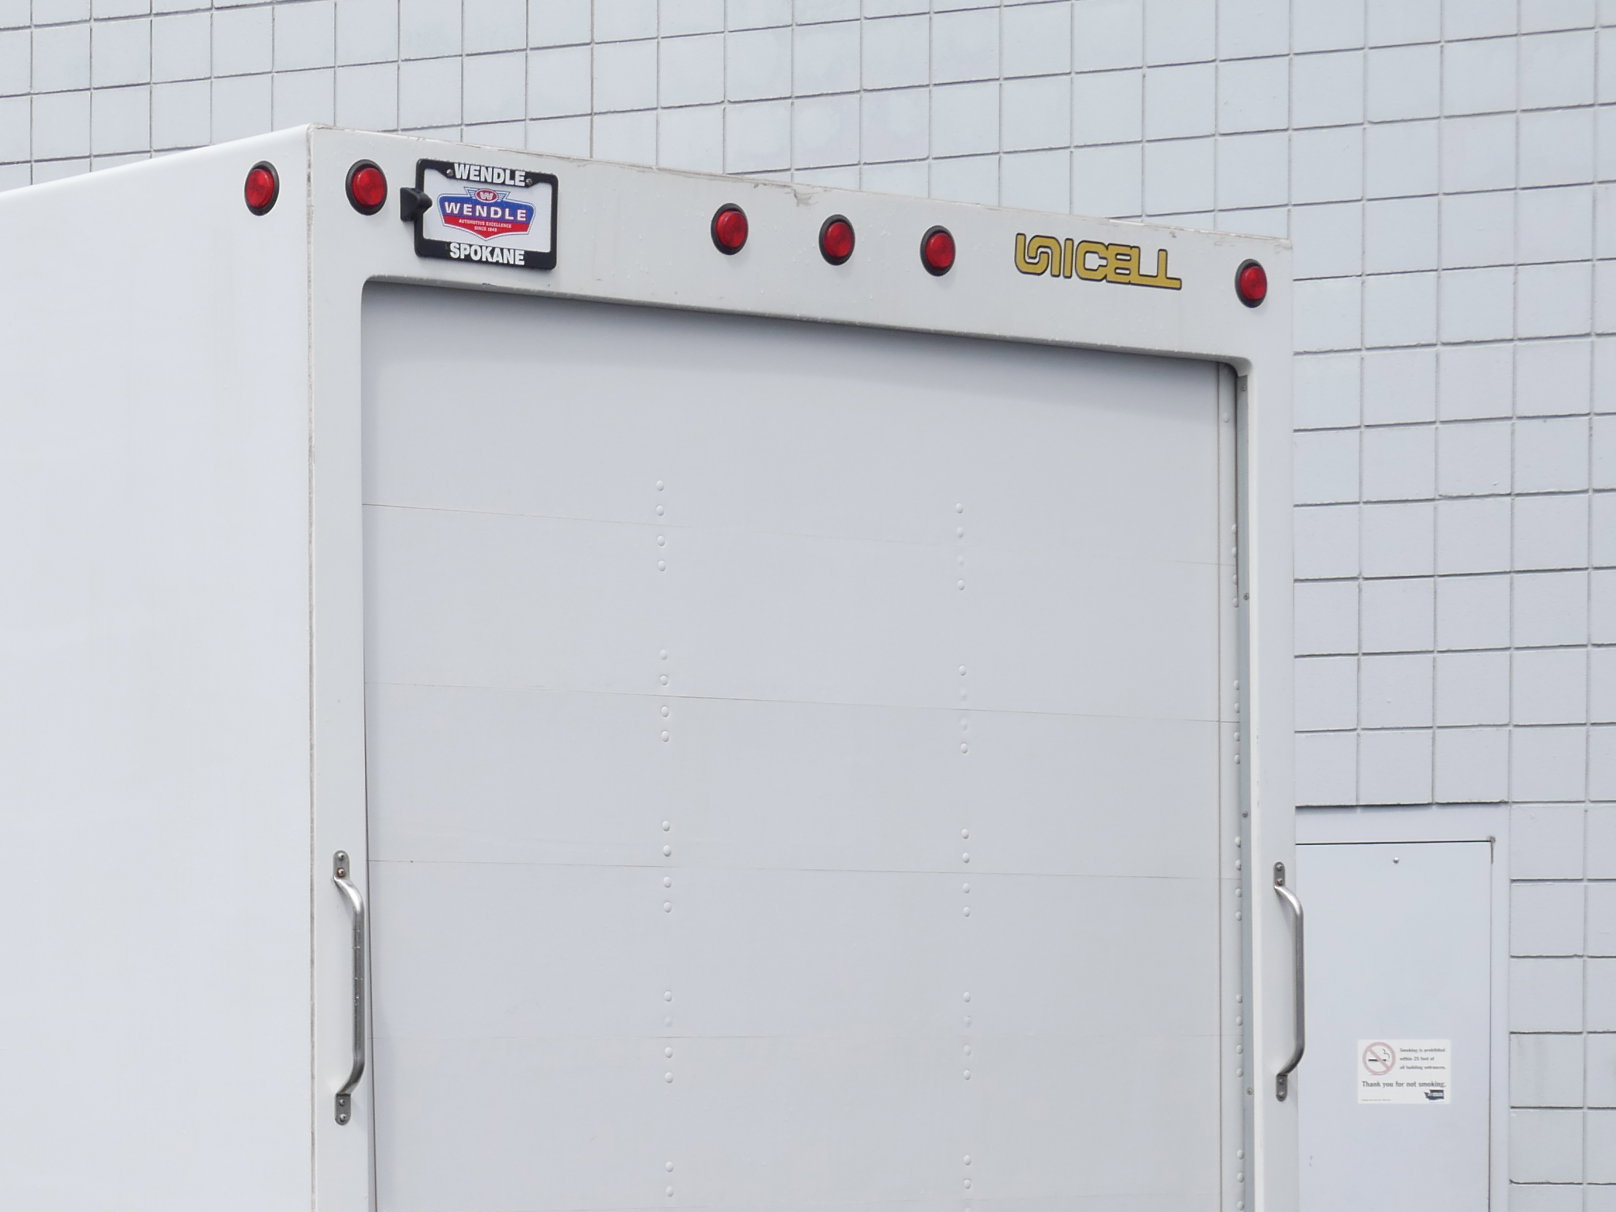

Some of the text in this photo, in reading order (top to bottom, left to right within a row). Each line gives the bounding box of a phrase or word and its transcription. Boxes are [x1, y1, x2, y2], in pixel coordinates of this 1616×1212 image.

[454, 163, 526, 187] WENDLE
[444, 202, 527, 221] WENDLE
[449, 243, 525, 265] SPOKANE
[1014, 232, 1183, 291] UNICELL
[1418, 1081, 1447, 1089] smoking.
